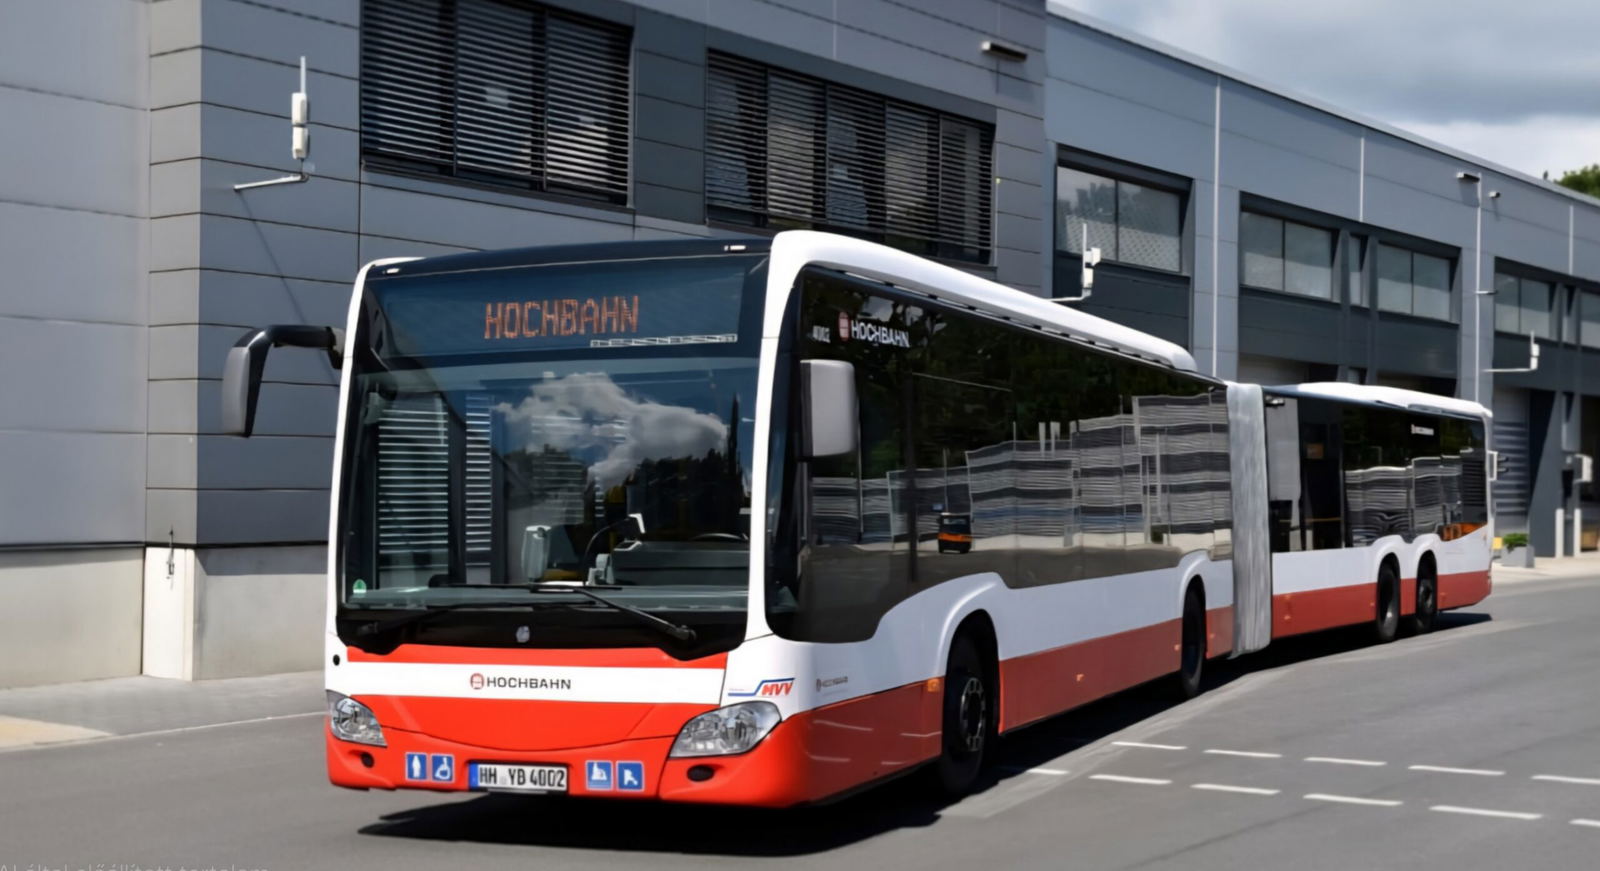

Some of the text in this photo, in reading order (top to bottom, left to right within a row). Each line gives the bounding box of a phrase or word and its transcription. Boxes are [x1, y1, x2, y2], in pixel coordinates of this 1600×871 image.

[485, 296, 639, 338] HOCHBAHN
[851, 320, 910, 348] HOCHBAHN
[487, 677, 571, 690] HOCHBAHN
[479, 767, 565, 787] HH YB 4002
